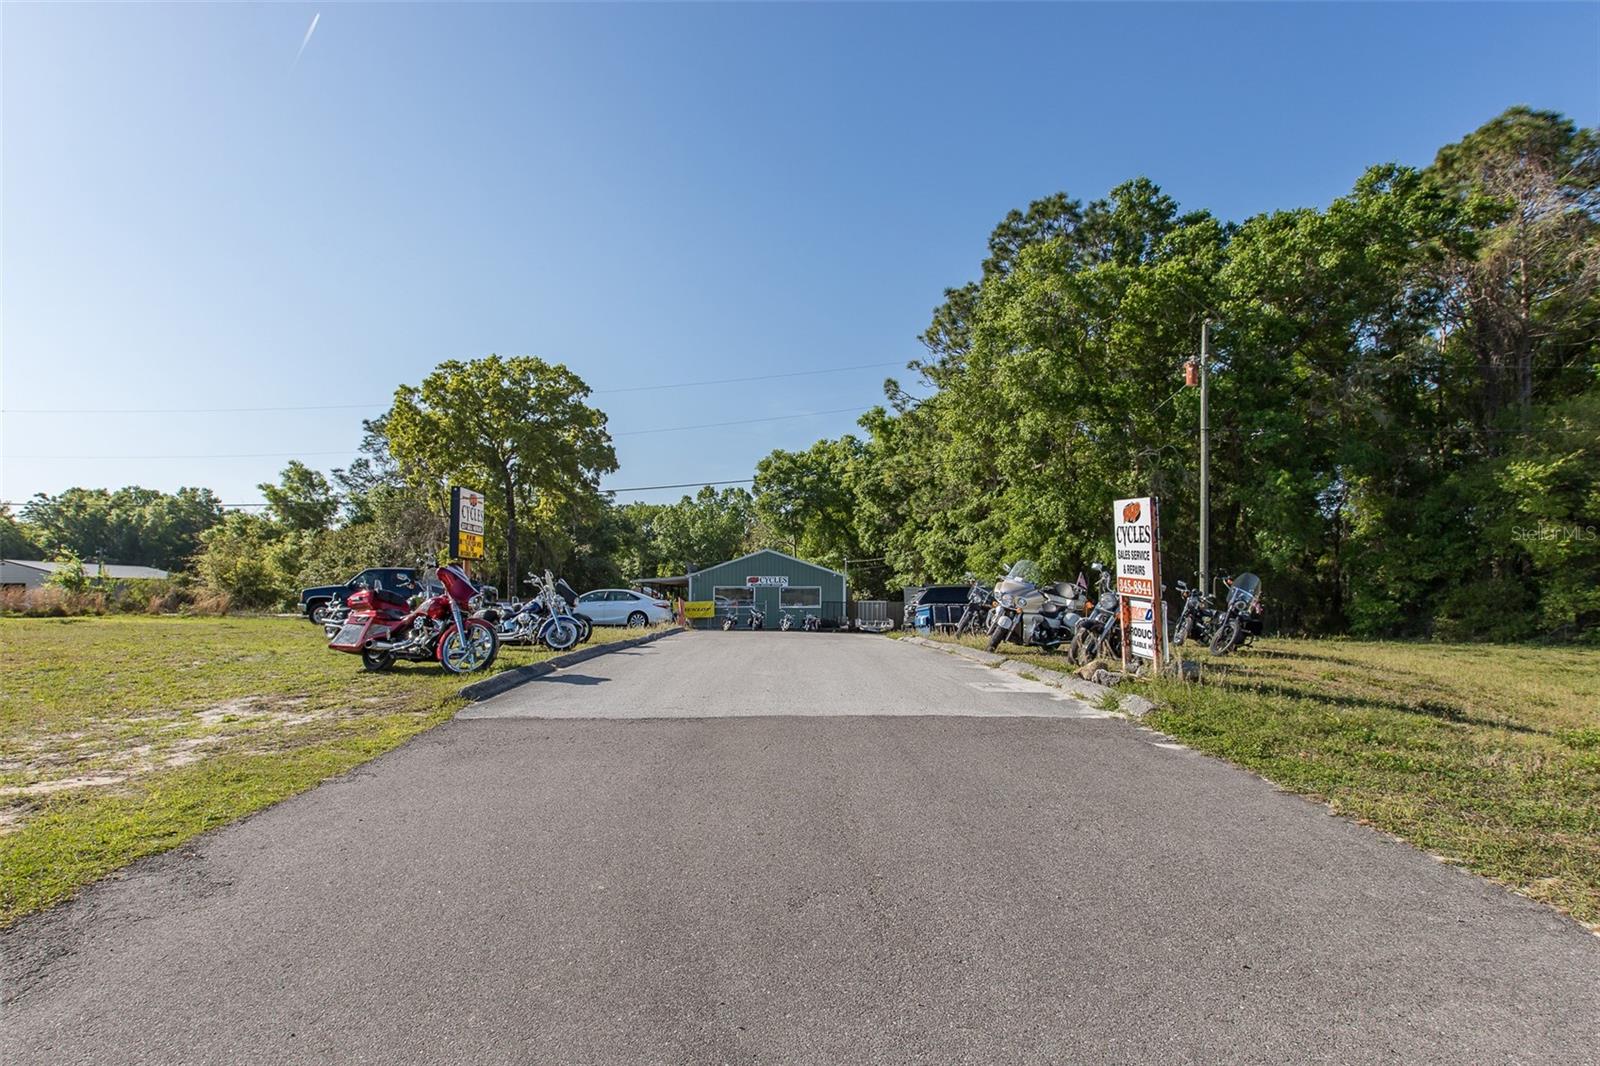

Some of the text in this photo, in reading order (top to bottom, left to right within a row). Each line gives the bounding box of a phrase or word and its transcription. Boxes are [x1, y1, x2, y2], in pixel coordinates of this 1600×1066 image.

[1117, 525, 1150, 547] CYCLES
[1118, 549, 1150, 561] SALES SERVICE
[1127, 565, 1146, 576] REPAIRS
[760, 576, 787, 584] CYCLES
